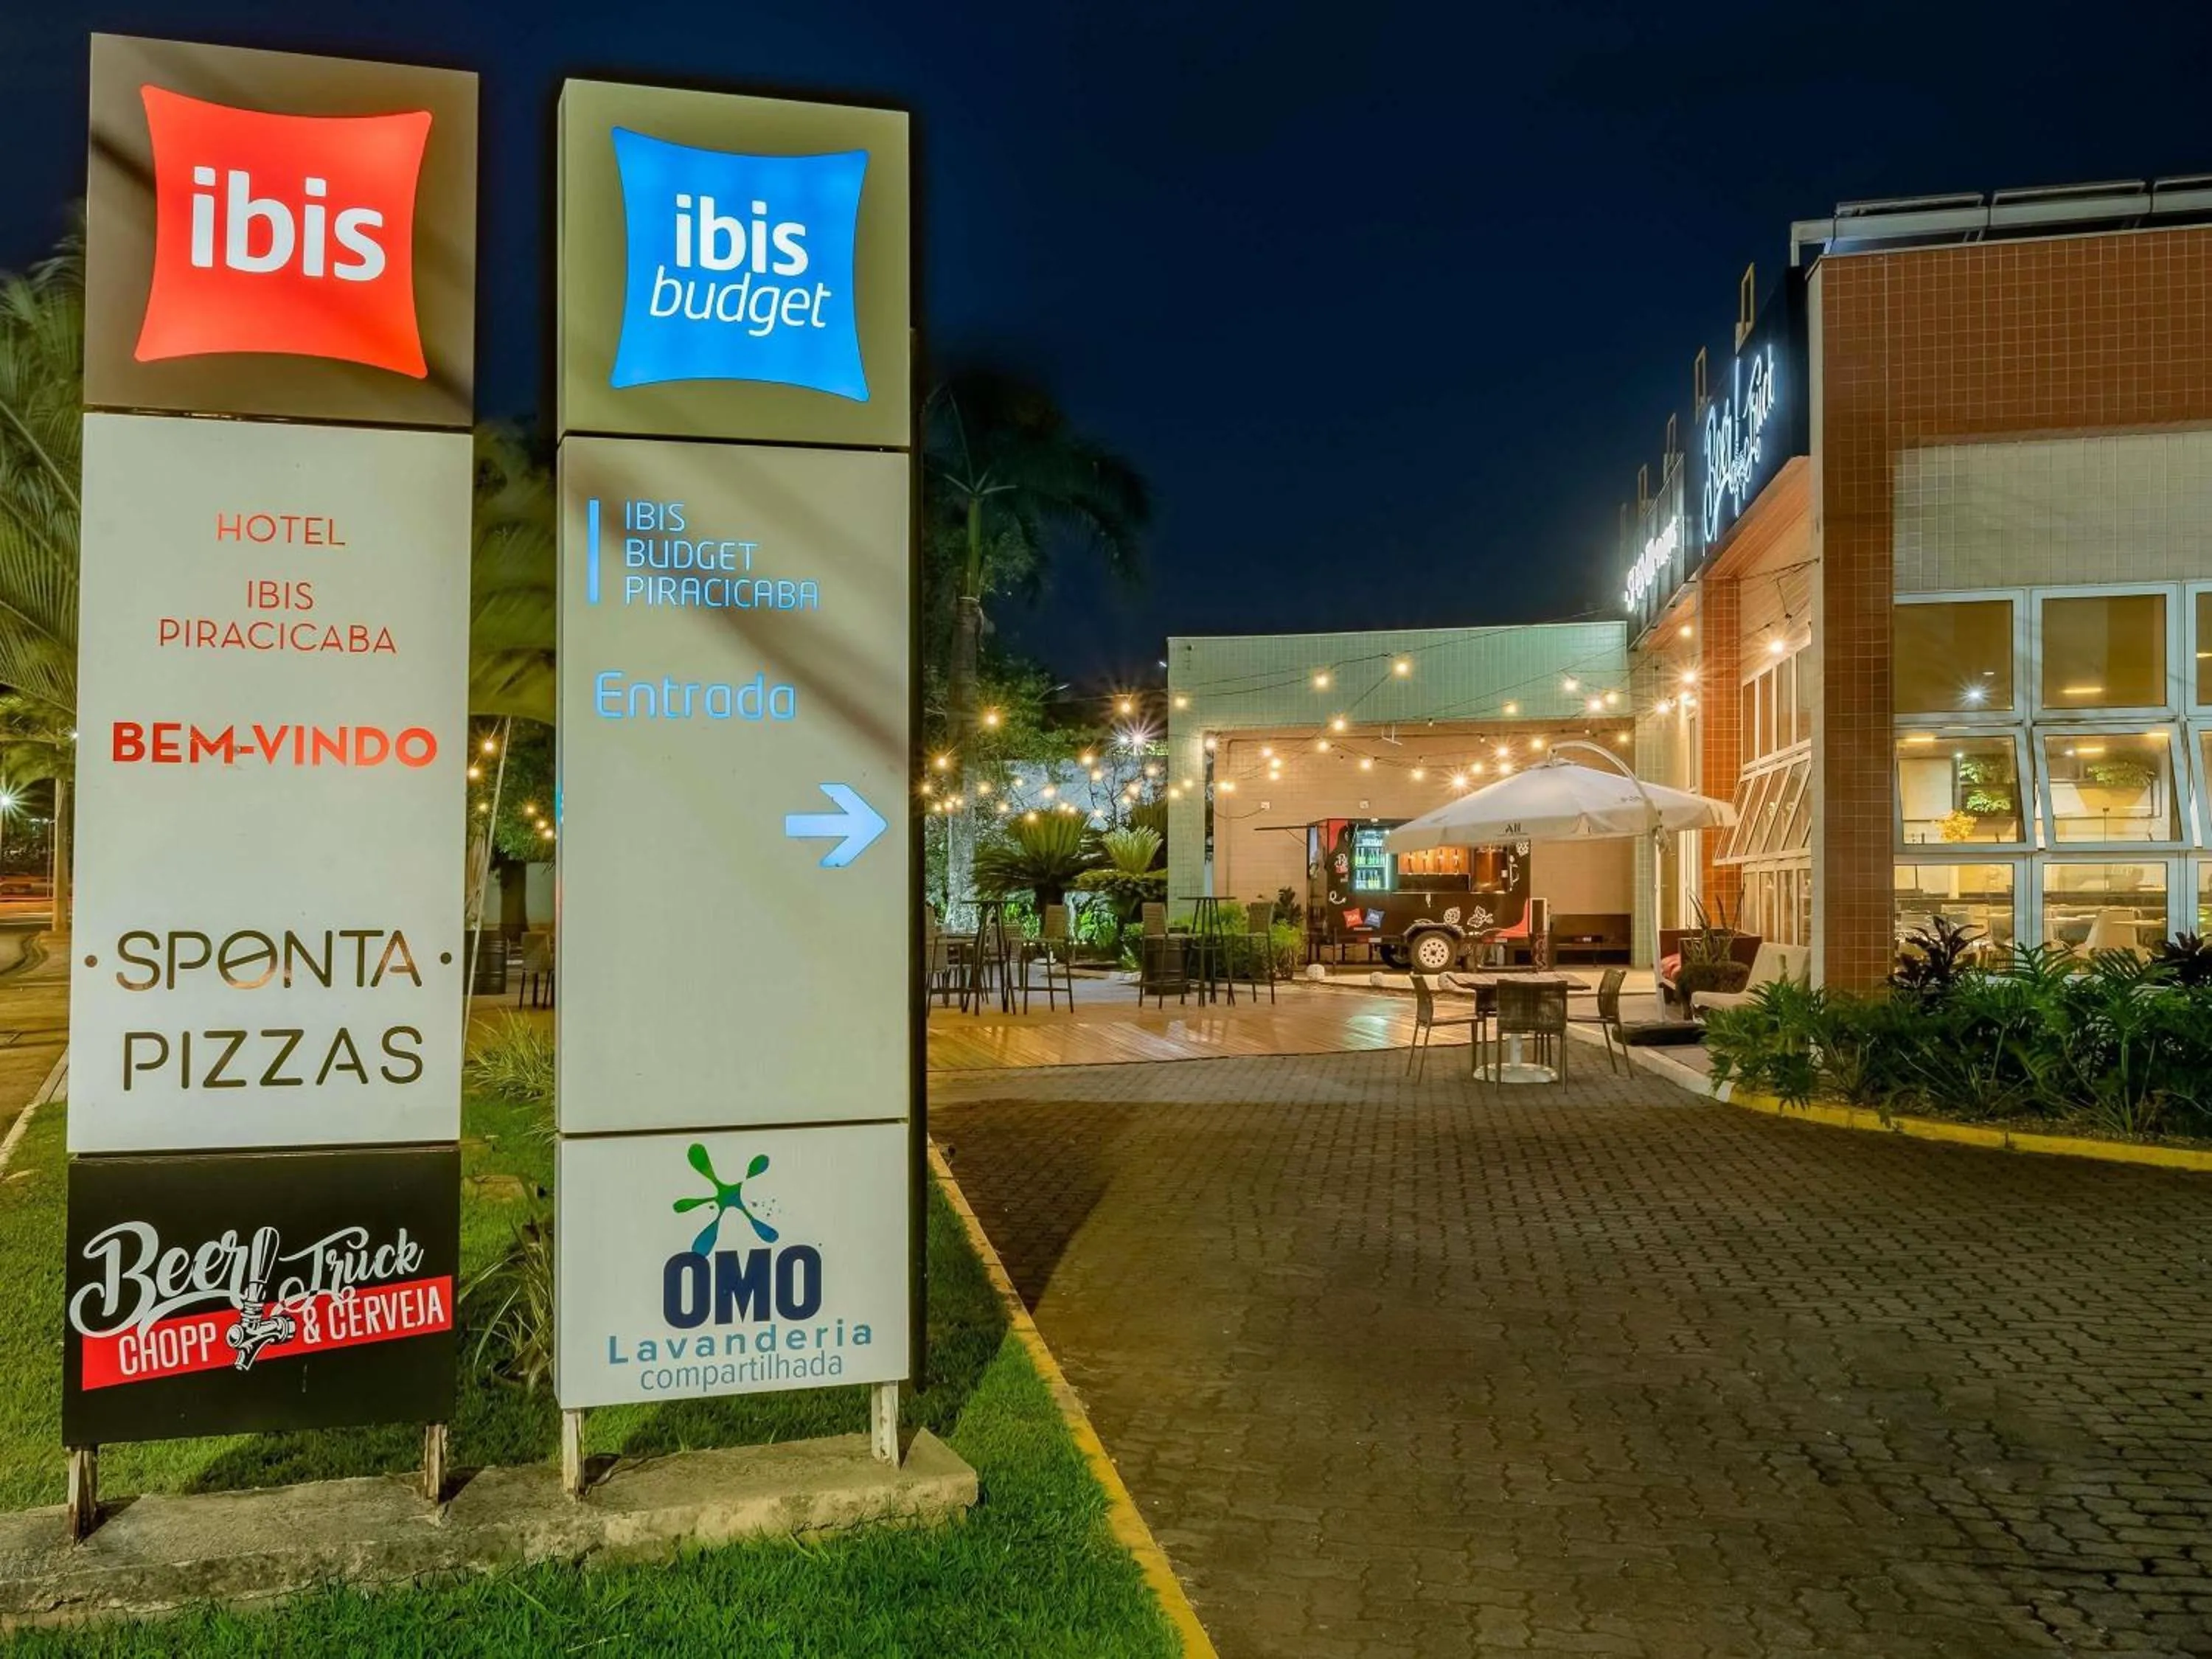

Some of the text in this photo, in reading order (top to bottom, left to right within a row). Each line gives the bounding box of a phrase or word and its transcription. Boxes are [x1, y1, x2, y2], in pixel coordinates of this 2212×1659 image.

[191, 166, 386, 281] ibis
[676, 194, 809, 276] ibis
[650, 265, 832, 337] budget
[217, 512, 346, 546] HOTEL
[625, 501, 686, 532] IBIS
[625, 538, 758, 571] BUDGET
[247, 580, 314, 611] IBIS
[625, 576, 820, 610] PIRACICABA
[159, 619, 396, 653] PIRACICABA
[596, 670, 796, 720] Entrada
[112, 722, 438, 768] BEM-VINDO
[123, 1026, 423, 1091] PIZZAS
[278, 1225, 425, 1313] Truck
[663, 1244, 822, 1329] OMO
[119, 1285, 445, 1375] CHOPP & CERVEJA
[608, 1318, 872, 1363] Lavanderia
[640, 1351, 843, 1392] compartilhada
